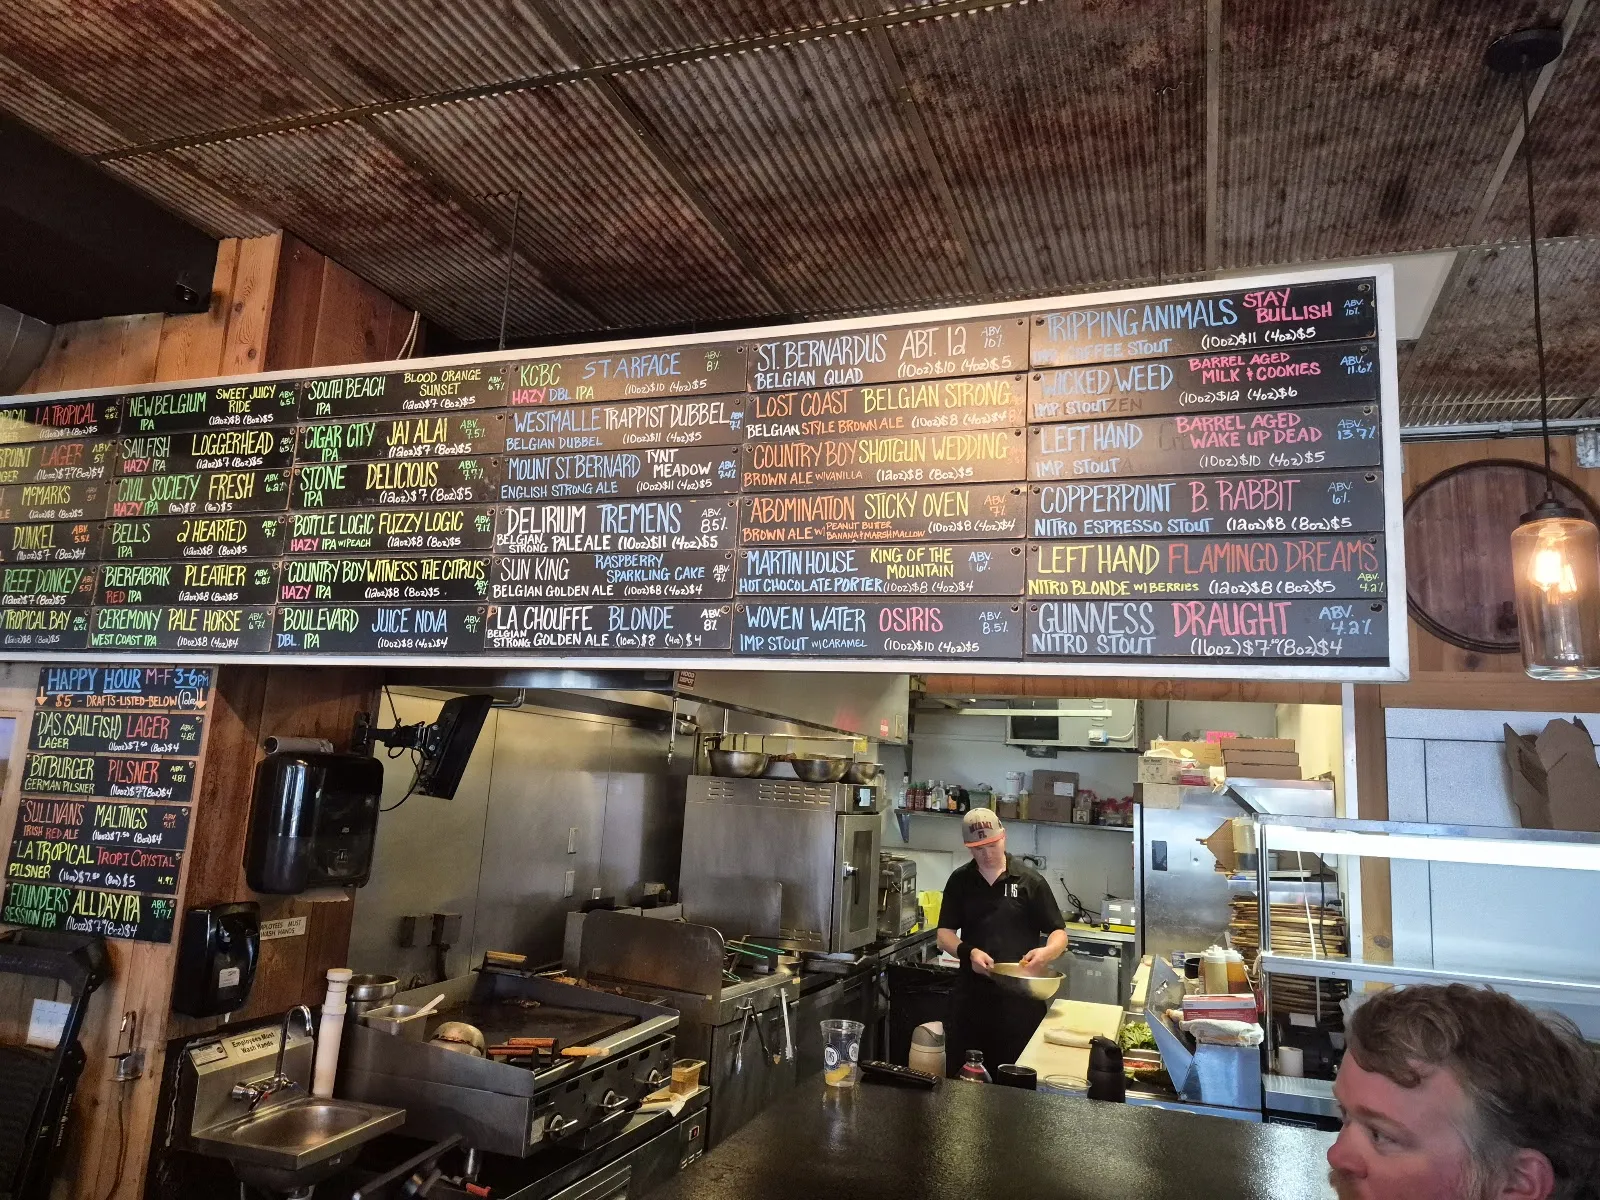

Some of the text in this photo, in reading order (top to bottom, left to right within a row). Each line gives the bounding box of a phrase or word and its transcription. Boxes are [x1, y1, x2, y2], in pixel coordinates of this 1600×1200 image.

[1242, 288, 1292, 308] STAY
[1047, 298, 1238, 341] TRIPPING ANIMALS
[1255, 301, 1333, 325] BULLISH
[757, 343, 780, 371] ST.
[782, 334, 887, 367] BERNARDUS
[948, 327, 967, 356] 12
[1127, 338, 1172, 356] STOUT
[1188, 353, 1290, 372] BARREL AGED
[1255, 363, 1321, 380] COOKIES
[404, 369, 481, 383] BLOOD ORANGE
[520, 363, 562, 387] KCBC
[754, 368, 863, 389] BELGIAN QUAD
[1042, 364, 1174, 395] WICKED WEED
[1202, 368, 1239, 385] MILK
[216, 385, 276, 399] SWEET JUICY
[308, 376, 386, 400] SOUTH BEACH
[419, 382, 461, 397] SUNSET
[512, 386, 595, 405] HAZY IPA
[228, 400, 251, 413] RIDE
[315, 402, 331, 415] IPA
[755, 381, 1012, 418] LOST COAST BELGIAN STRONG
[52, 403, 97, 426] TROPICAL
[513, 402, 731, 433] WESTMALLE TRAPPIST DUBBEL
[304, 418, 448, 449] CIGAR CITY JAI ALAI
[746, 417, 904, 438] BELGIAN BROWN ALE
[1041, 422, 1144, 454] LEFT HAND
[122, 431, 274, 459] SAILFISH LOGGERHEAD
[506, 438, 555, 451] BELGIAN
[1190, 428, 1322, 450] WAKE DEAD
[40, 444, 84, 467] LAGER
[645, 449, 679, 463] TYNT
[753, 443, 825, 469] COUNTRY
[825, 440, 859, 467] BOY
[858, 439, 925, 464] SHOTGUN
[931, 432, 1009, 462] WEDDING
[300, 461, 439, 491] STONE DELICIOUS
[507, 457, 554, 481] MOUNT
[653, 462, 712, 478] MEADOW
[1073, 457, 1120, 474] STOUT
[150, 473, 255, 501] SOCIETY FRESH
[501, 481, 618, 499] ENGLISH STRONG ALE
[1040, 479, 1300, 513] COPPERPOINT B. RABBIT
[750, 491, 970, 522] ABOMINATION STICKY OVEN
[293, 511, 464, 537] BOTTLE LOGIC FUZZY LOGIC
[506, 502, 682, 535] DELIRIUM TREMENS
[862, 521, 892, 529] BUTTER
[1034, 518, 1214, 535] NITRO ESPRESSO STOUT
[12, 525, 56, 550] DUNKEL
[192, 520, 247, 542] HEARTED
[787, 528, 812, 540] ALE
[322, 537, 337, 550] IPA
[551, 535, 610, 551] PALE ALE
[594, 554, 664, 569] RASPBERRY
[747, 550, 858, 575] MARTIN HOUSE
[870, 548, 953, 563] KING OF THE
[1168, 540, 1378, 574] FLAMINGO DREAMS
[104, 565, 247, 587] BIERFABRIK PLEATHER
[366, 559, 485, 582] WITNESS CITRUS
[500, 557, 531, 581] SUN
[606, 567, 705, 584] SPARKLING CAKE
[887, 564, 954, 579] MOUNTAIN
[34, 568, 83, 594] DONKEY
[546, 585, 588, 597] GOLDEN
[739, 577, 883, 592] HOT CHOCOLATE PORTER
[1028, 579, 1130, 595] NITRO BLONDE
[5, 610, 71, 630] TROPICAL BAY
[98, 609, 242, 631] CEREMONY HORSE
[283, 608, 447, 633] BOULEVARD JUICE NOVA
[496, 606, 674, 631] LA CHOUFFE BLONDE
[746, 606, 944, 633] WOVEN WATER OSIRIS
[1038, 601, 1292, 637] GUINNESS DRAUGHT
[91, 634, 114, 646] WEST
[48, 668, 141, 691] HAPPY HOUR
[126, 716, 170, 739] LAGER
[30, 755, 160, 784] BITBURGER PILSNER
[24, 778, 95, 794] GERMAN PILSNER
[94, 805, 148, 829] MALTINGS
[968, 822, 993, 834] MIAMI
[9, 883, 125, 920] FOUNDERS DAY
[231, 1031, 275, 1048] Employees Must
[241, 1040, 274, 1054] Wash Hands
